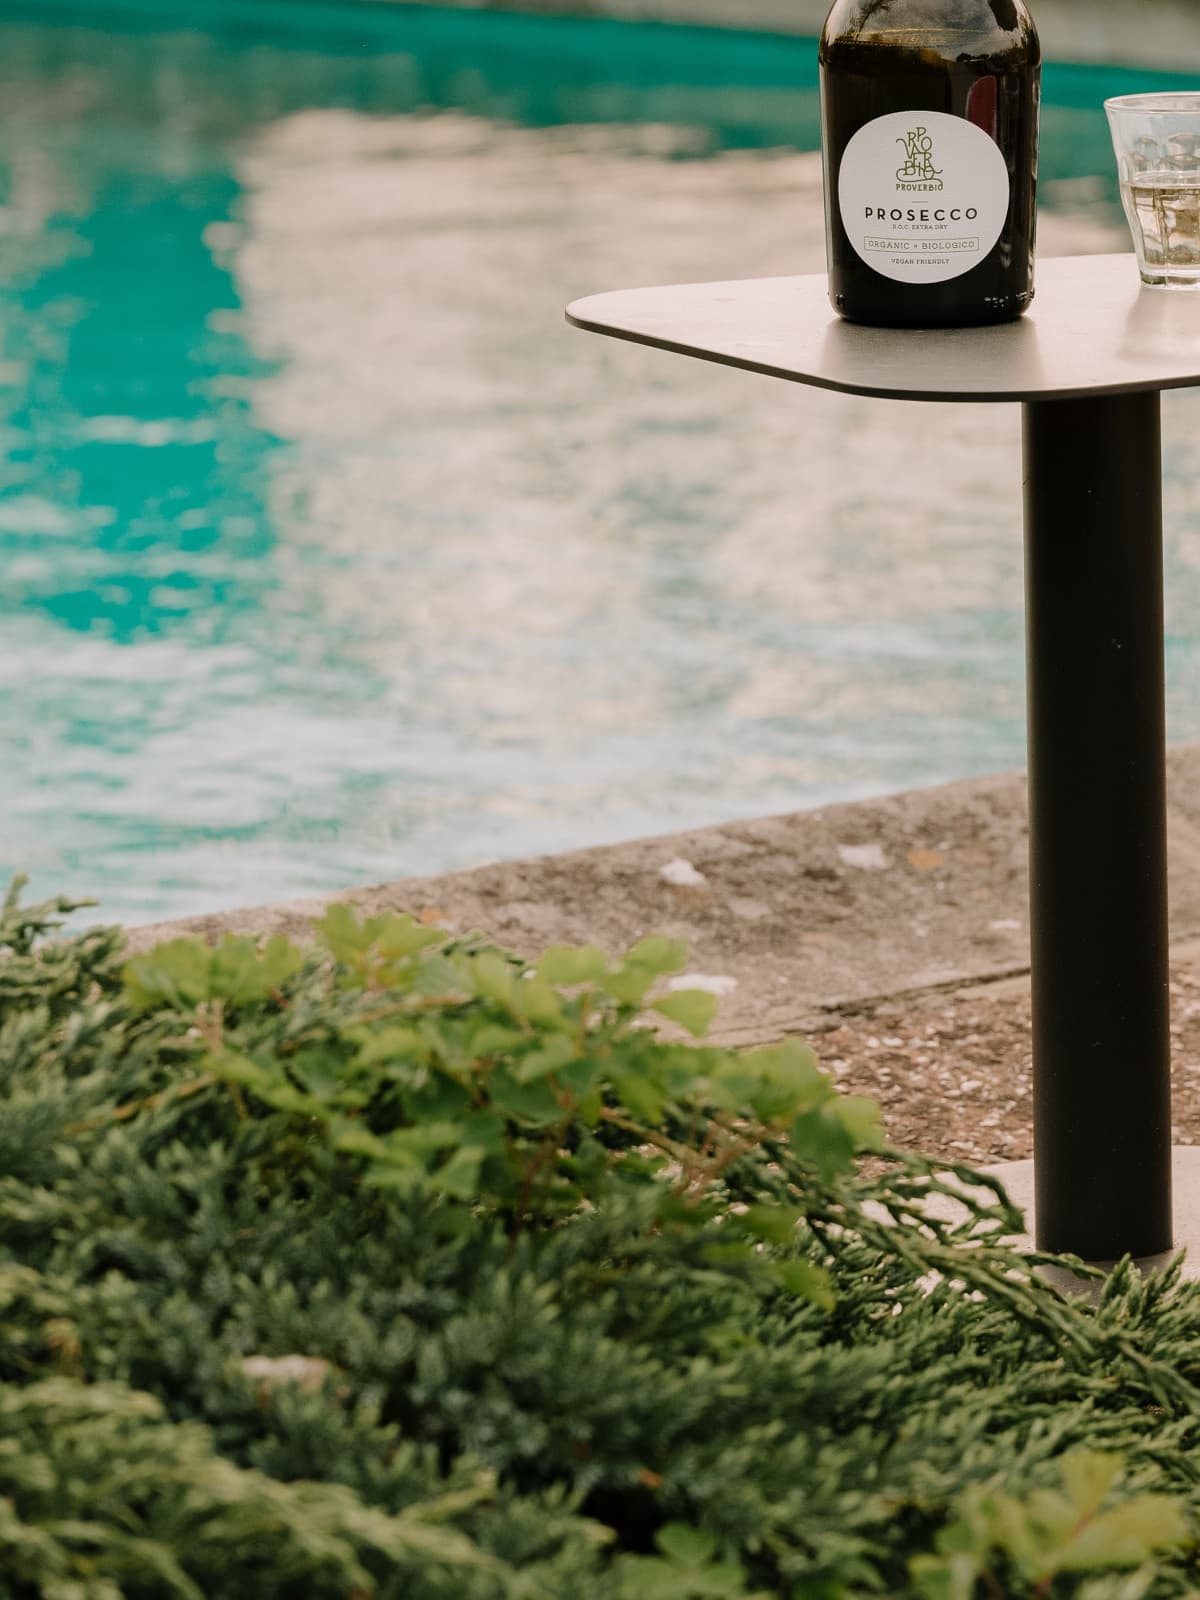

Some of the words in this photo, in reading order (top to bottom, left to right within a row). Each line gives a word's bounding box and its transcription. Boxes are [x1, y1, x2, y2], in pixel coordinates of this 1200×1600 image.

[896, 183, 943, 192] PROVERBIO
[865, 207, 978, 221] PROSECCO
[868, 240, 911, 250] ORGANIC
[921, 240, 975, 250] BIOLOGICO
